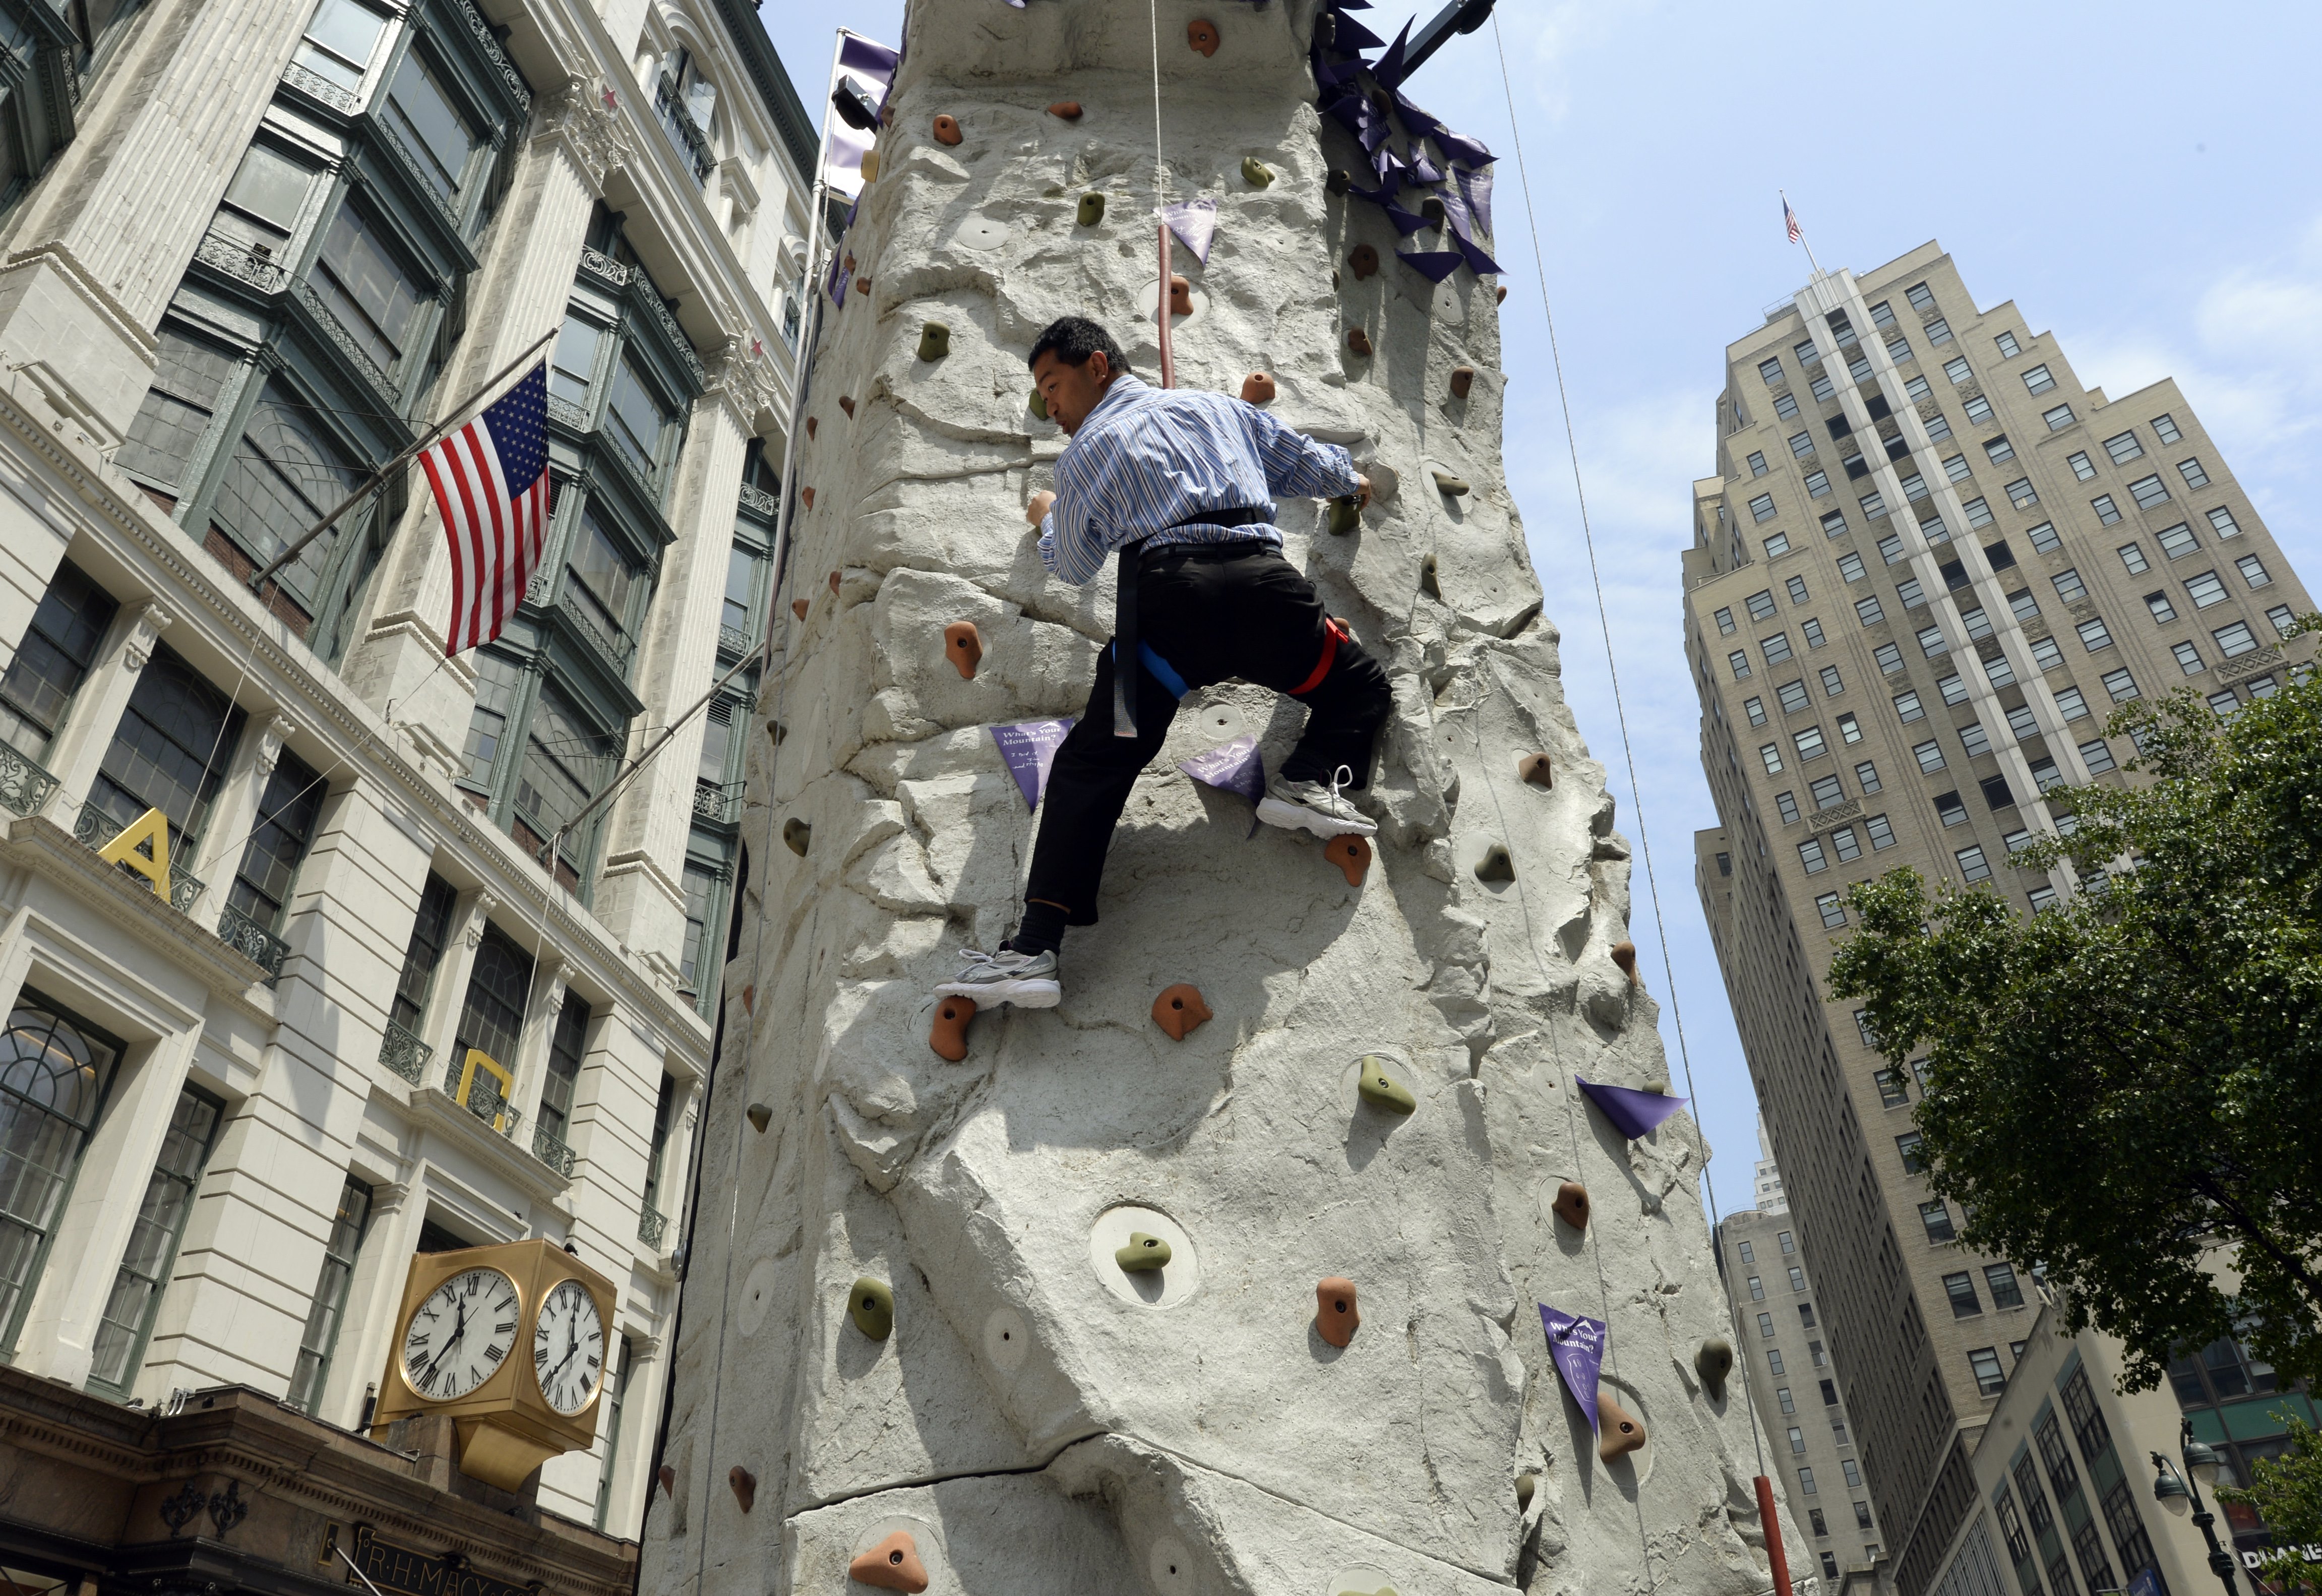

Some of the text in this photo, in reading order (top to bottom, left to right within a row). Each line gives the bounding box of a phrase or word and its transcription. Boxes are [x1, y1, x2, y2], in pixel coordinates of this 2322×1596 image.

[1003, 734, 1056, 746] Mountain?
[1197, 748, 1251, 773] What's Your
[1204, 755, 1251, 779] Mountain?
[98, 807, 171, 903] A
[443, 1285, 457, 1308] XI
[464, 1276, 480, 1297] XII
[495, 1297, 512, 1313] II
[559, 1289, 568, 1311] XI
[423, 1307, 440, 1323] X
[546, 1301, 557, 1322] X
[495, 1322, 514, 1333] III
[537, 1324, 550, 1341] IX
[1577, 1329, 1598, 1342] Your
[411, 1332, 431, 1346] IX
[1553, 1333, 1595, 1354] Mountain?
[444, 1372, 456, 1393] VI
[471, 1365, 481, 1384] V
[555, 1383, 563, 1406] VI
[572, 1386, 578, 1406] V
